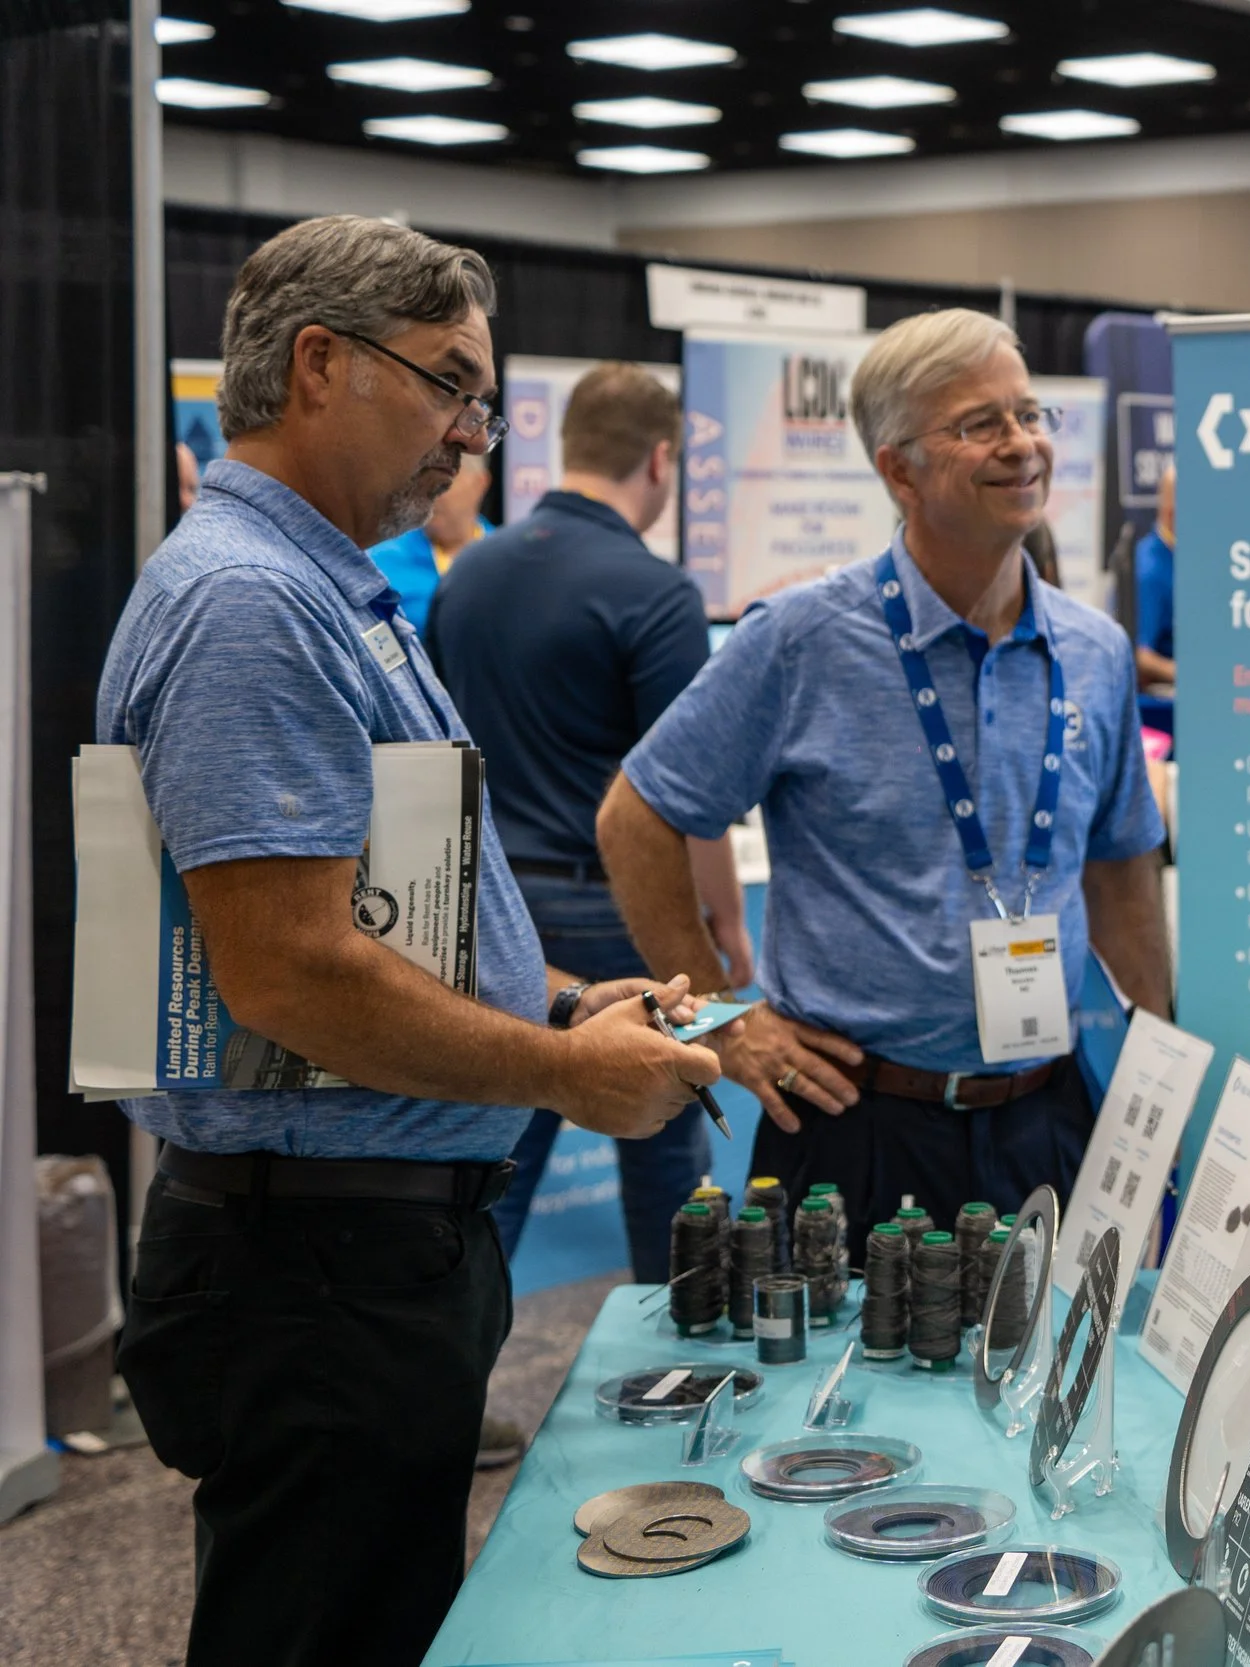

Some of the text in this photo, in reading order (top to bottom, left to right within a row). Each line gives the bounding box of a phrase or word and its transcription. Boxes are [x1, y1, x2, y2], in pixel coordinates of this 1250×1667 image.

[464, 815, 472, 839] Reuse
[462, 840, 472, 866] Water
[353, 888, 381, 901] RENT
[443, 872, 452, 905] turnkey
[423, 901, 431, 916] Rent
[460, 882, 472, 933] Hydrotesting
[406, 920, 414, 946] Liquid
[421, 929, 430, 946] Rain
[442, 935, 448, 944] to
[440, 945, 448, 982] xpertise
[457, 950, 468, 982] Storage
[166, 926, 185, 1079] Limited Resources
[186, 979, 201, 1020] Peak
[206, 989, 218, 1000] is
[205, 1002, 218, 1030] Rent
[184, 1024, 203, 1079] During
[204, 1032, 217, 1051] for
[203, 1053, 216, 1078] Rain
[1232, 1509, 1241, 1527] PX2
